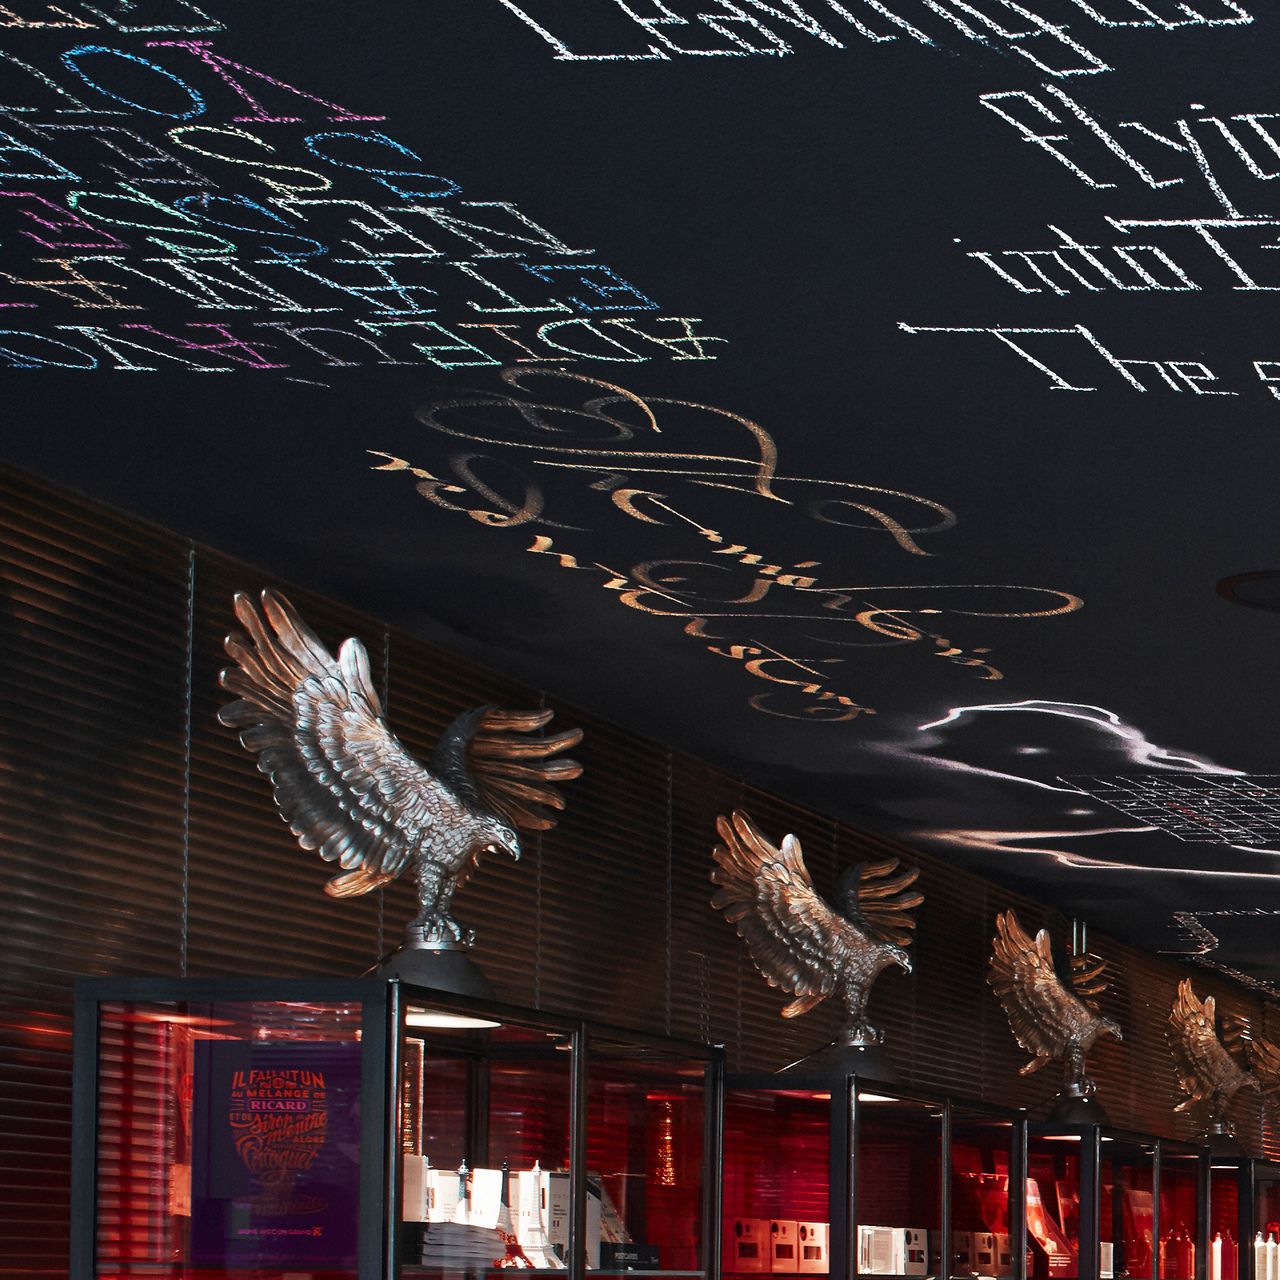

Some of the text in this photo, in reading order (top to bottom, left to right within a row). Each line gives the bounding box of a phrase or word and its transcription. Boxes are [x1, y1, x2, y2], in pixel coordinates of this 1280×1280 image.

[253, 314, 730, 372] ADIEU
[893, 324, 1240, 396] The
[251, 1100, 307, 1111] RICARD
